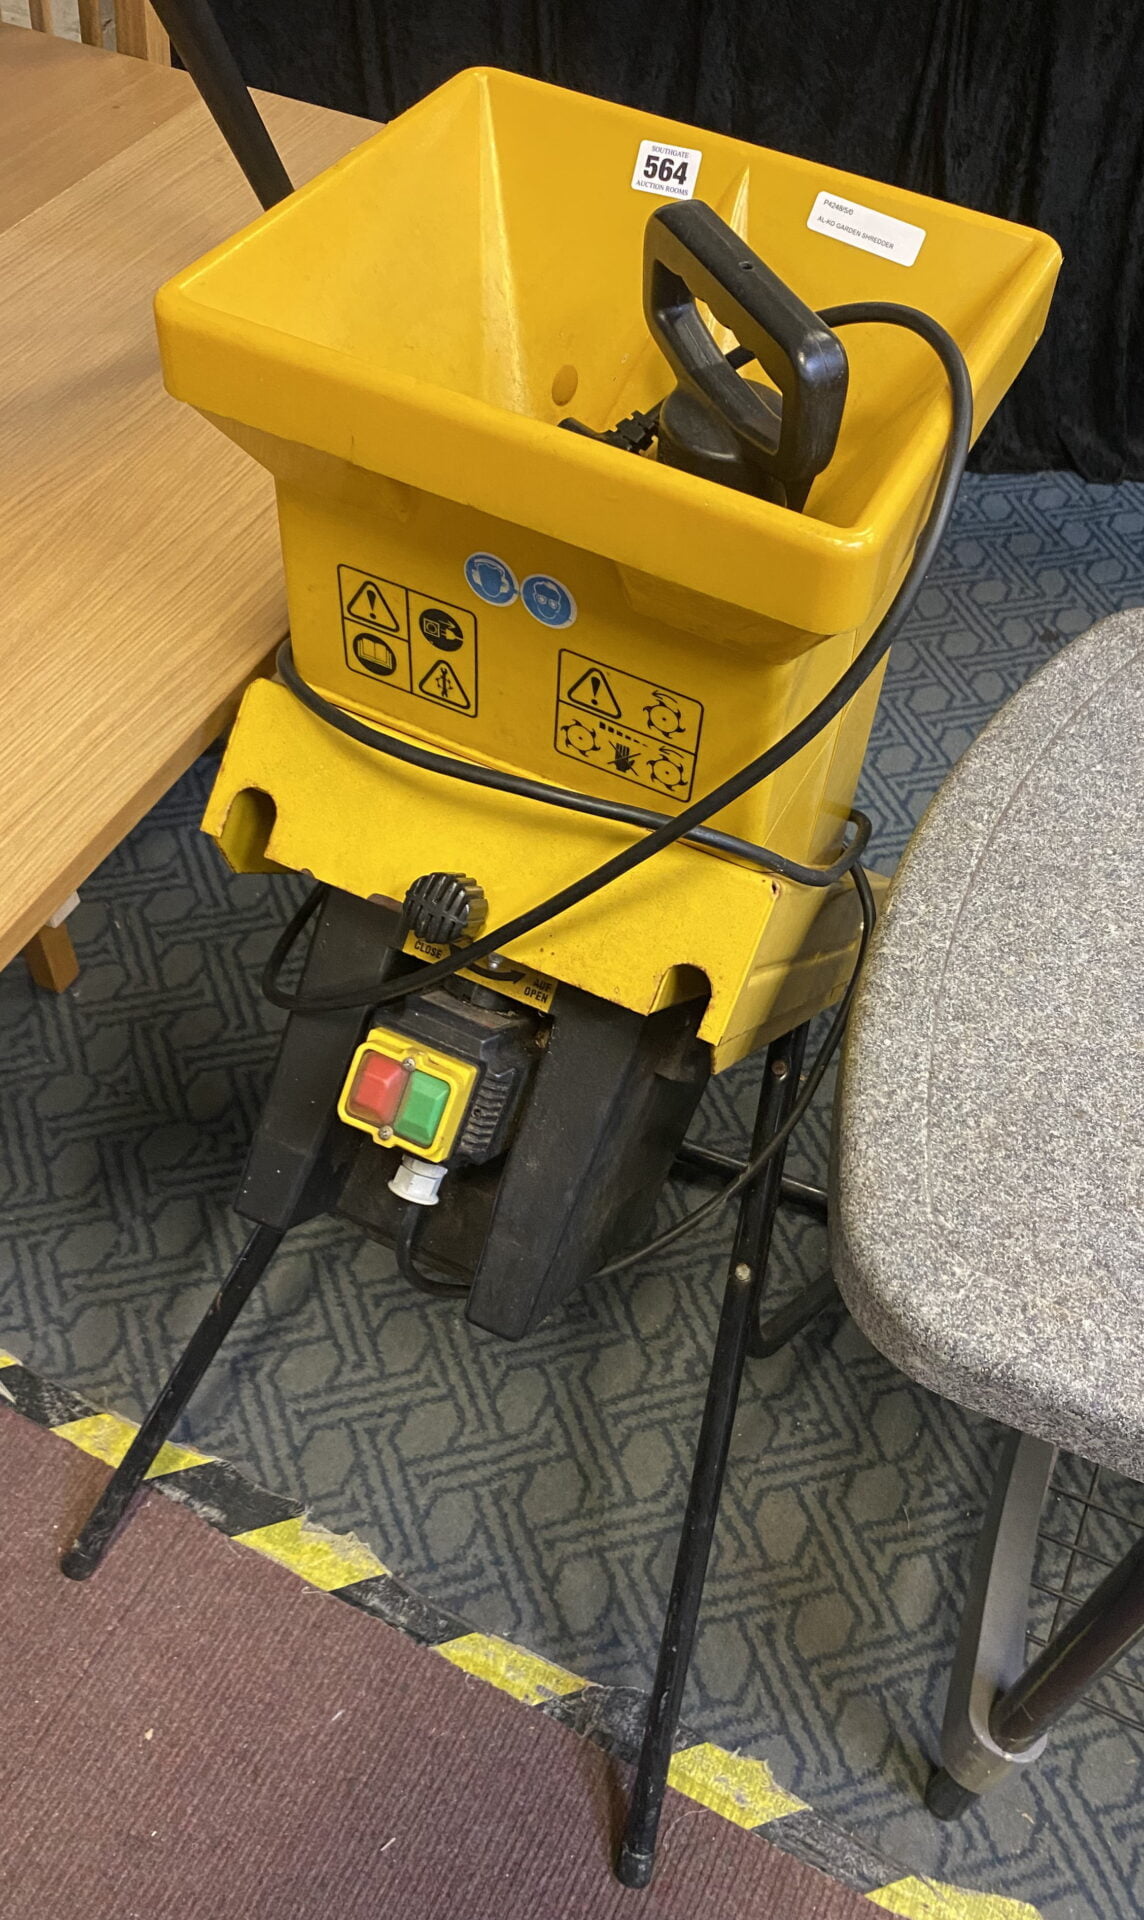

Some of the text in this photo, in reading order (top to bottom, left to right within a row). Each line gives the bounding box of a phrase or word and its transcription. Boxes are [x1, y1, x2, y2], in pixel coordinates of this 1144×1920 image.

[652, 145, 689, 159] SOUTHGATE
[643, 154, 688, 185] 564
[636, 180, 689, 196] AUCTION ROOMS
[817, 215, 895, 250] AL-KO GARDEN SHREDDER
[414, 940, 442, 959] CLOSE
[524, 986, 549, 1003] OPEN
